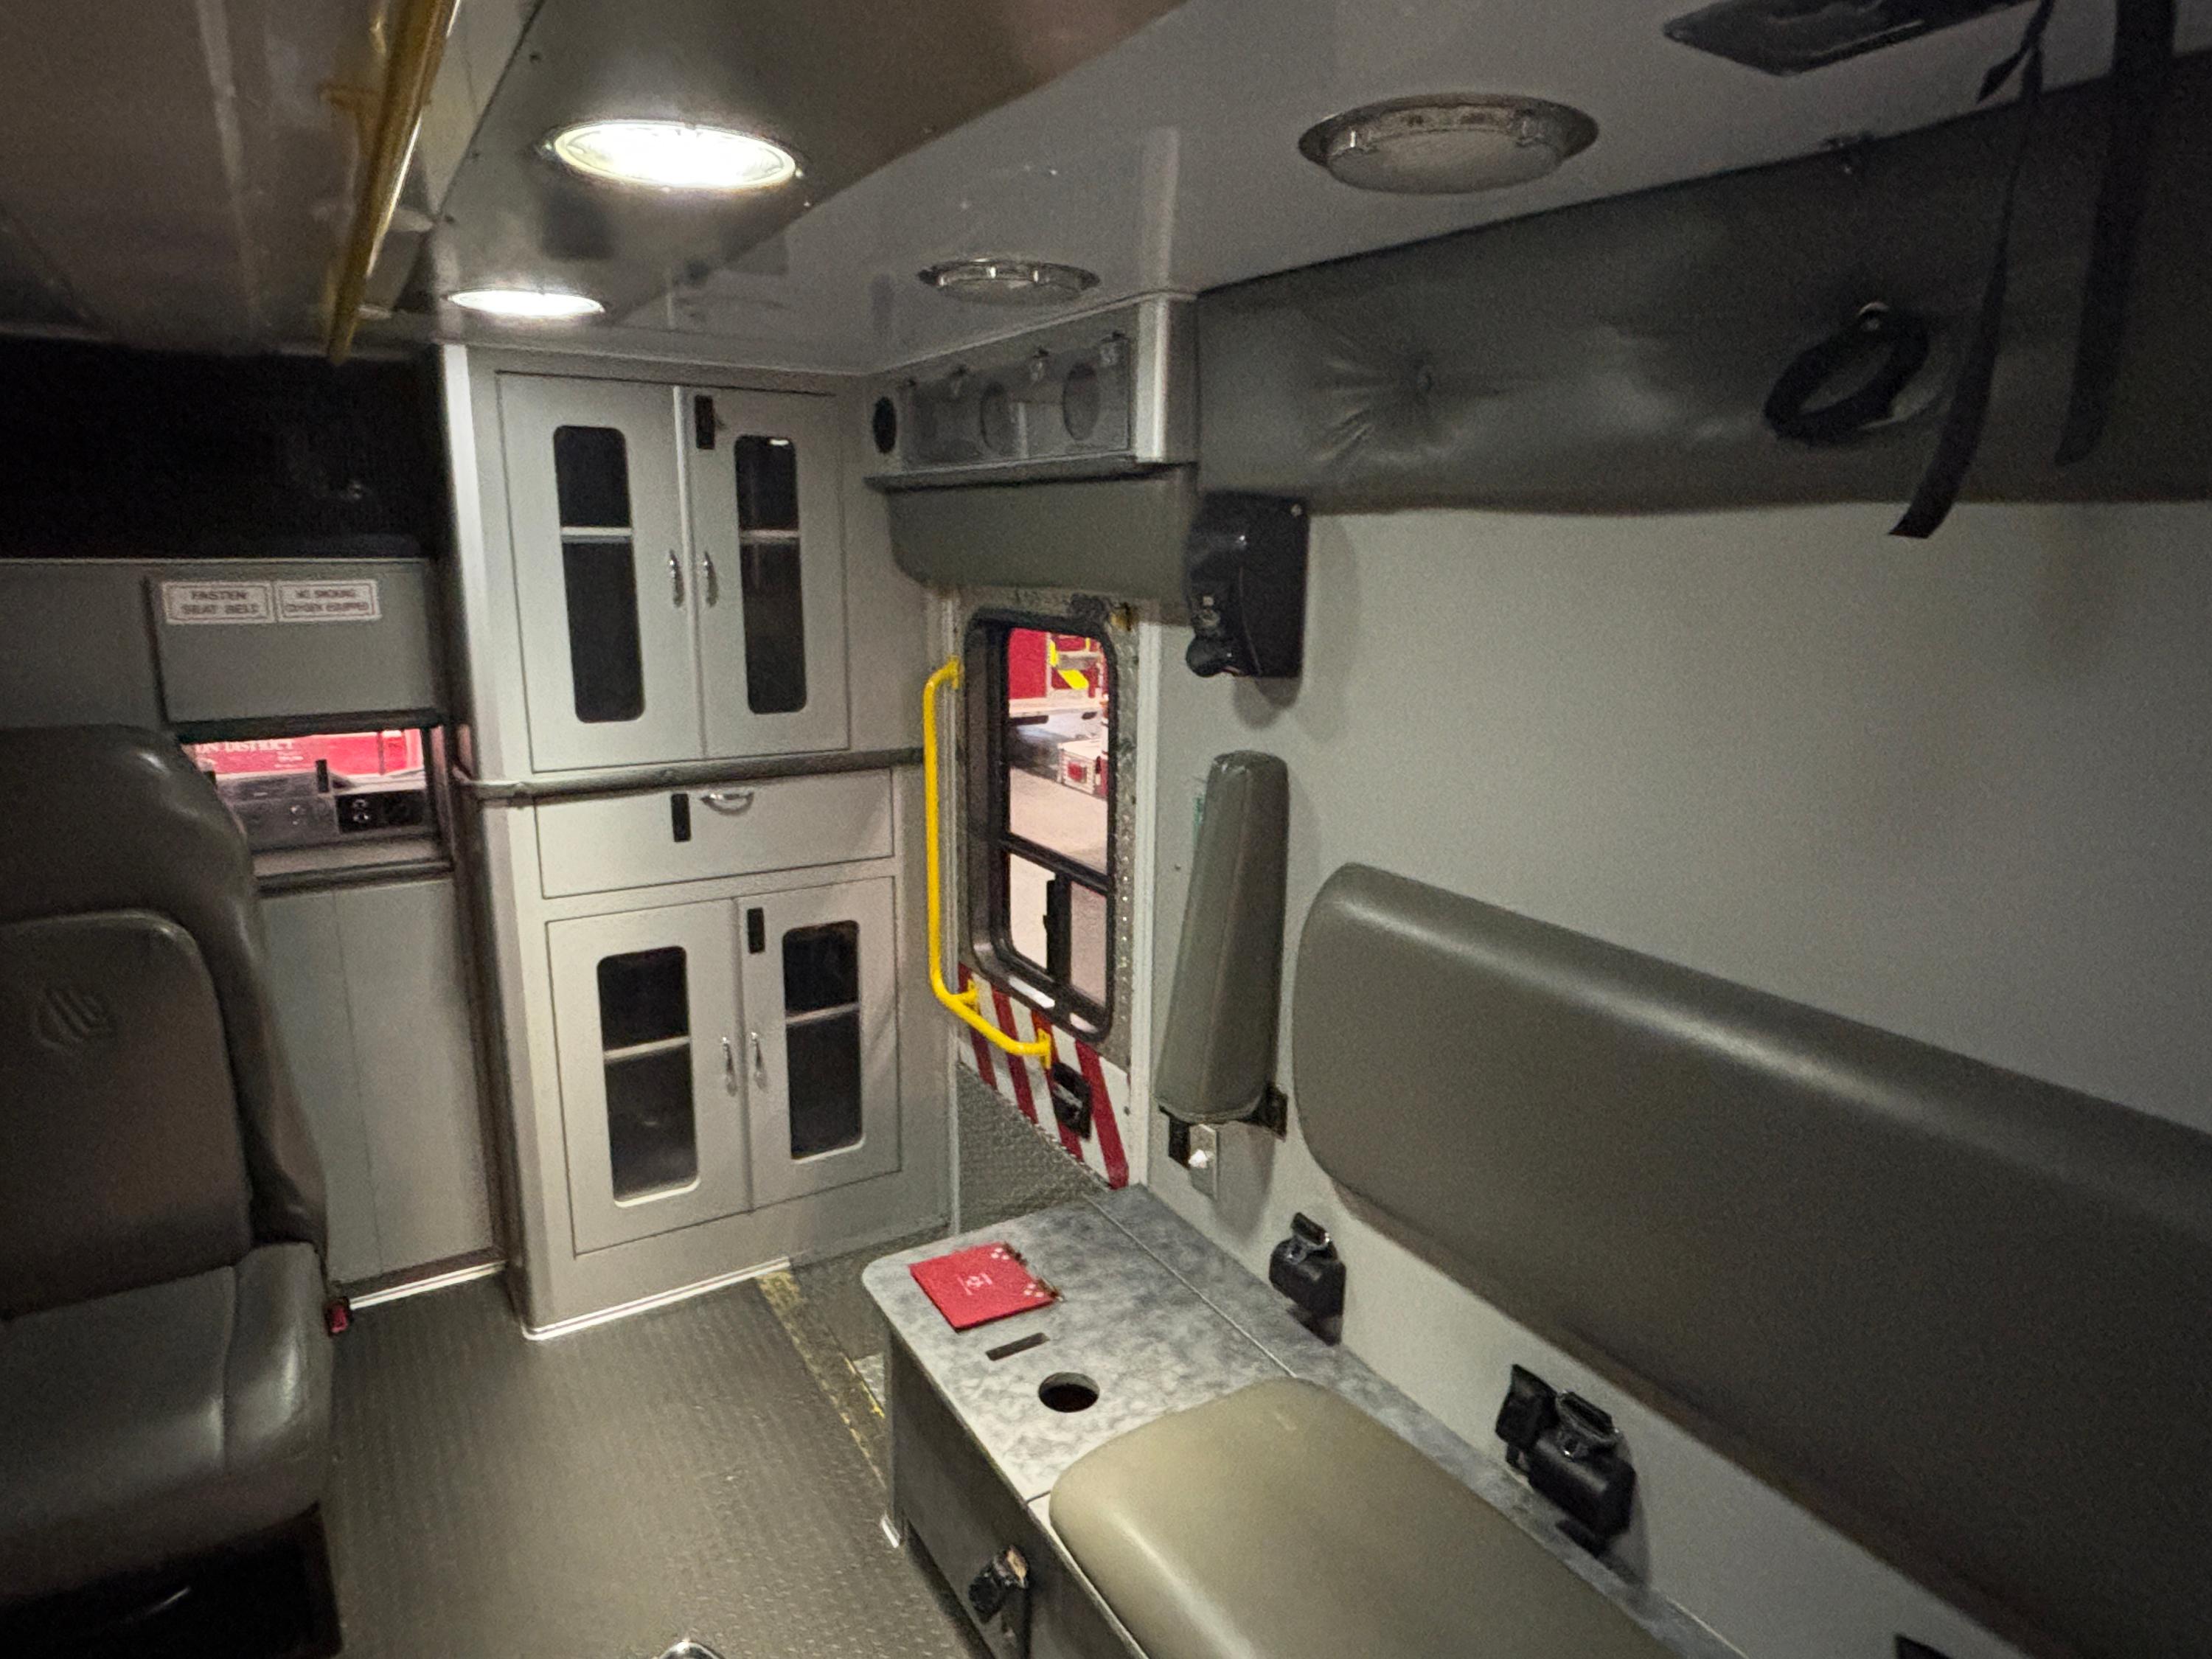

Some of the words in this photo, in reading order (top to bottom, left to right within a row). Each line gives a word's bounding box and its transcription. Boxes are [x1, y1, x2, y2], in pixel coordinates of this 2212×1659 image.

[191, 590, 247, 600] FASTEN
[181, 603, 218, 614] SEAT
[224, 739, 293, 753] DISTRICT
